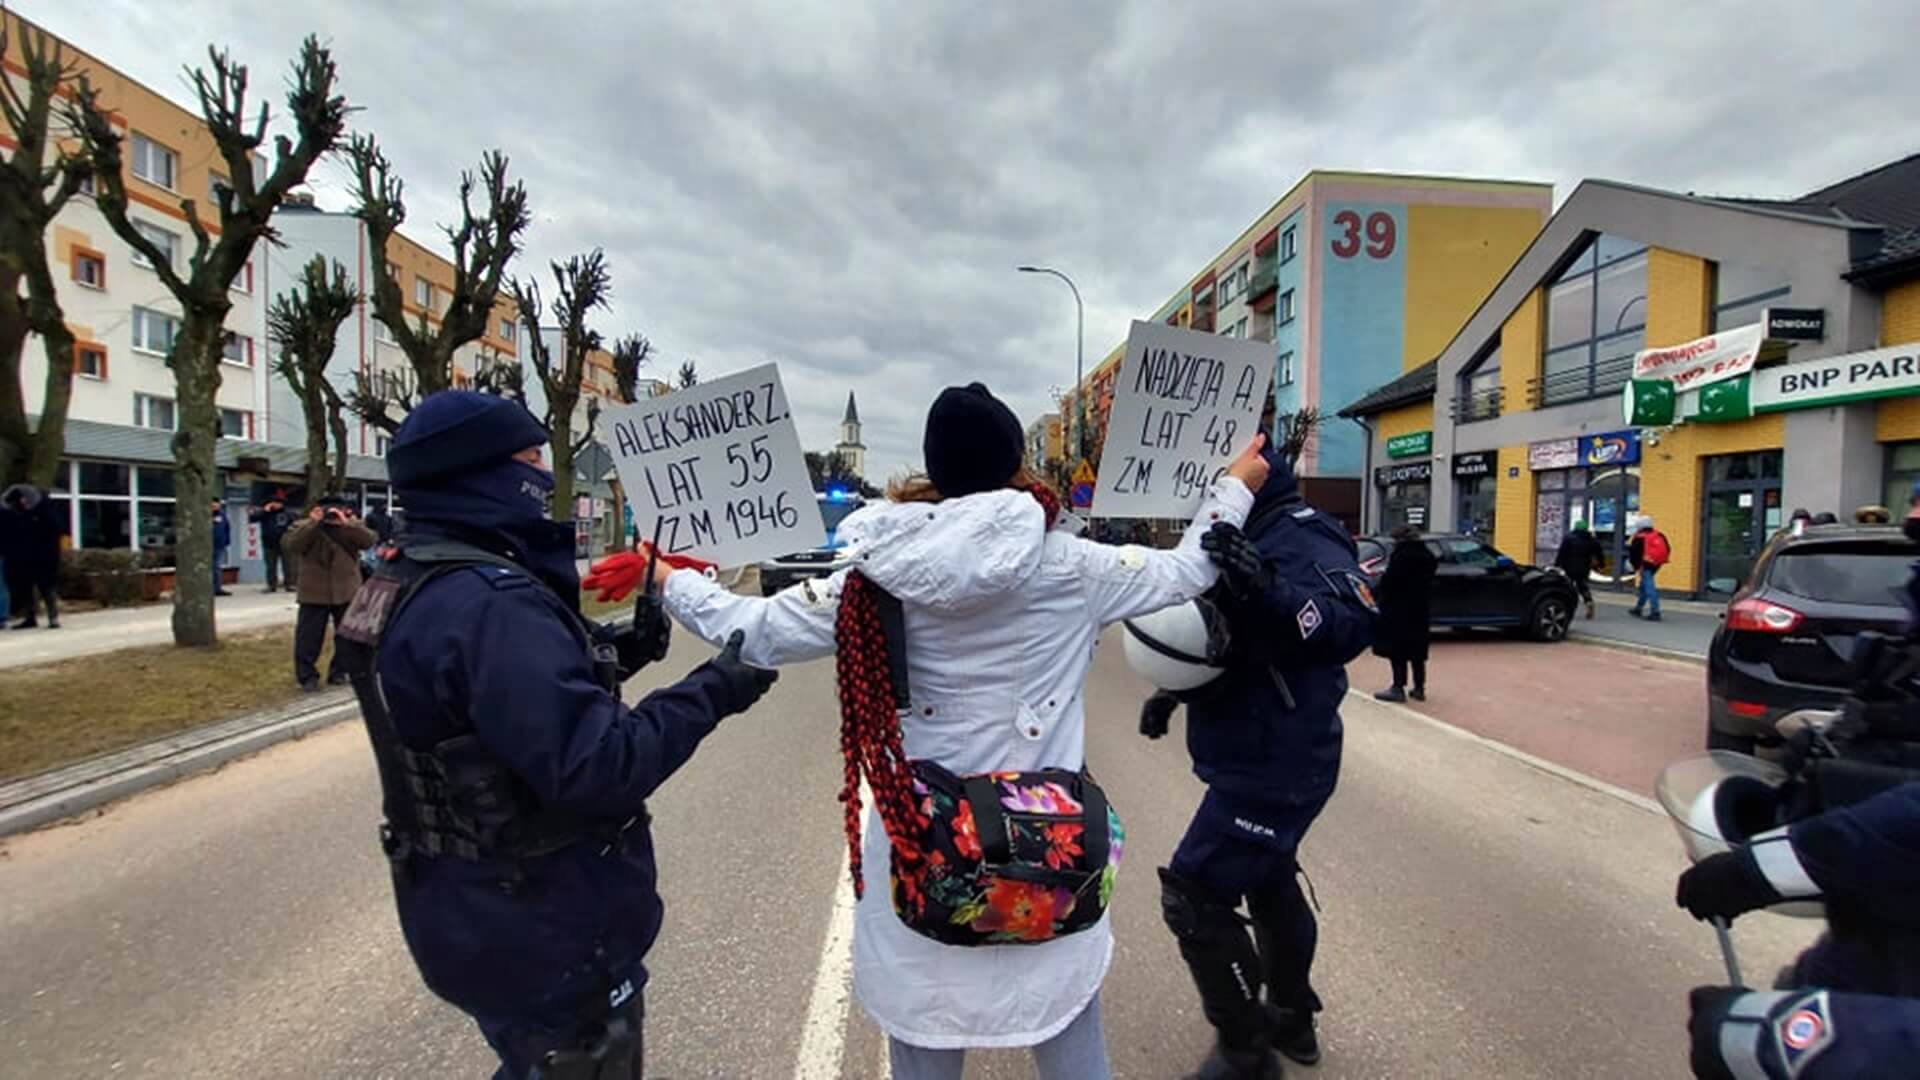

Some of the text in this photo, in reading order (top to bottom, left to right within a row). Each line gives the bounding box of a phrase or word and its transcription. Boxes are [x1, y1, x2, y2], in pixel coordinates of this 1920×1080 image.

[1331, 209, 1396, 259] 39
[1771, 318, 1821, 330] ADWOKAT
[1135, 345, 1257, 412] NADZIEJA A.
[1780, 368, 1840, 394] BNP
[614, 382, 791, 458] ALEKSANDER Z.
[1141, 406, 1237, 457] LAT 48
[645, 434, 773, 510] LAT 55
[1113, 457, 1155, 495] ZM
[664, 490, 799, 554] ZM 1946
